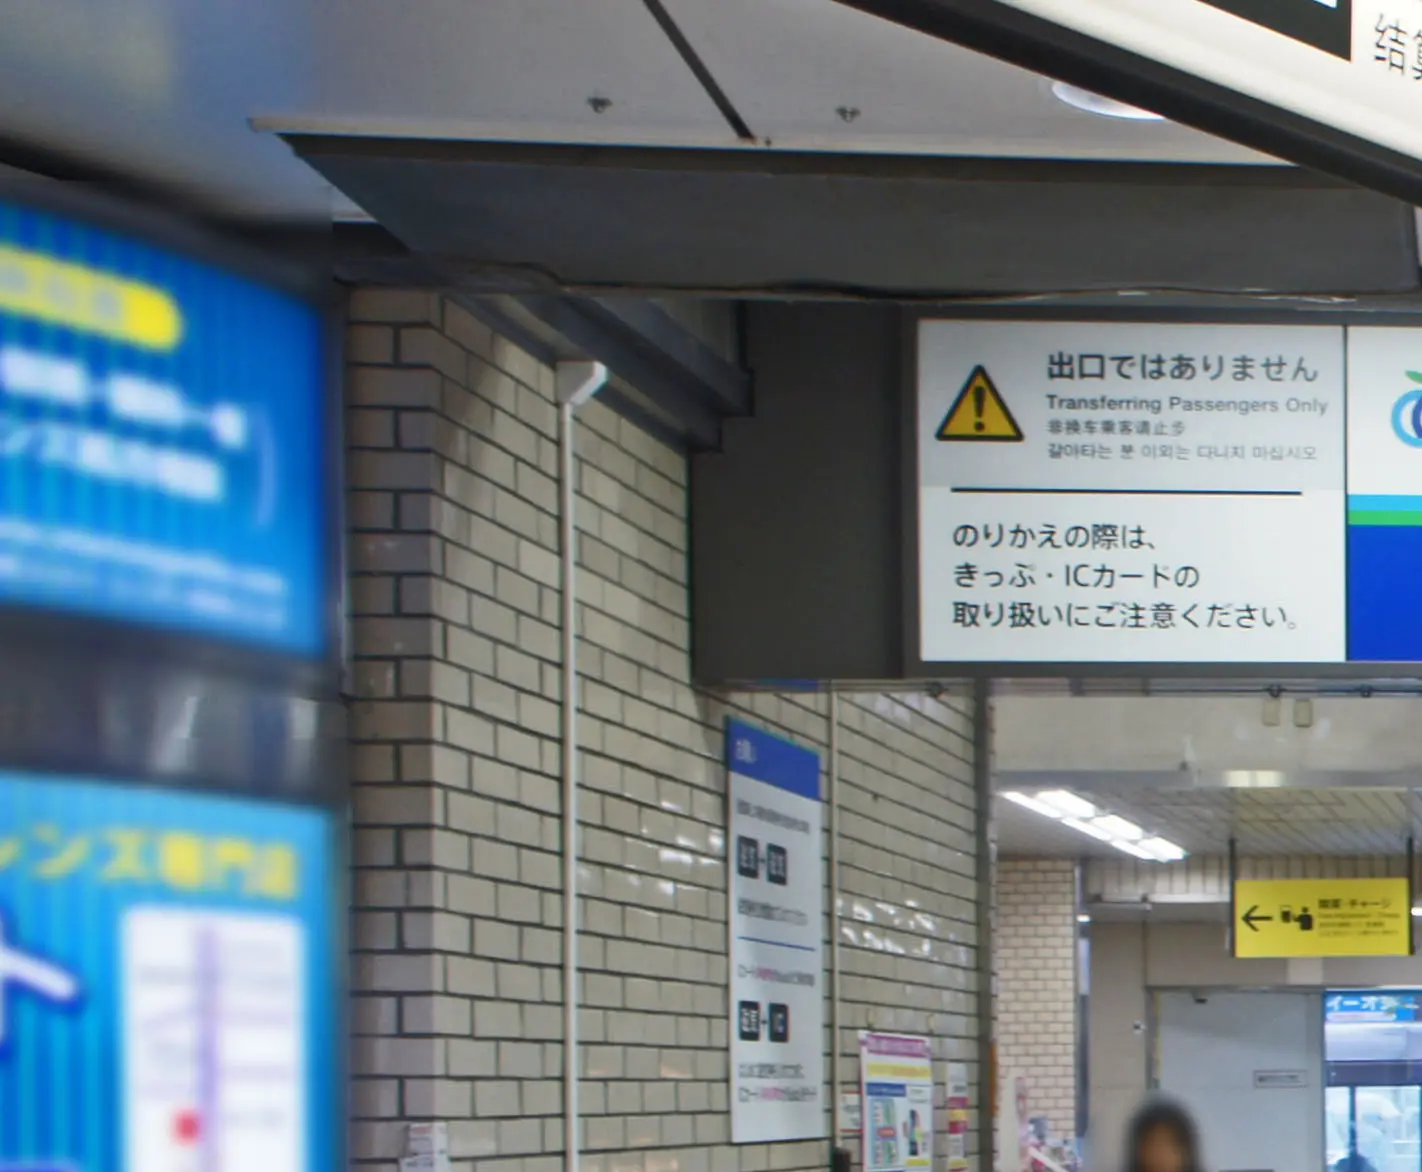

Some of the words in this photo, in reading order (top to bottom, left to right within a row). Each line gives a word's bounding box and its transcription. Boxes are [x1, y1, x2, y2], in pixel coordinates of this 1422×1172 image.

[1047, 352, 1320, 383] 出口ではありません
[1045, 394, 1163, 415] Transferring
[1169, 397, 1279, 416] Passengers
[1285, 398, 1329, 416] Only
[952, 602, 1298, 631] 取り扱いにご注意ください。
